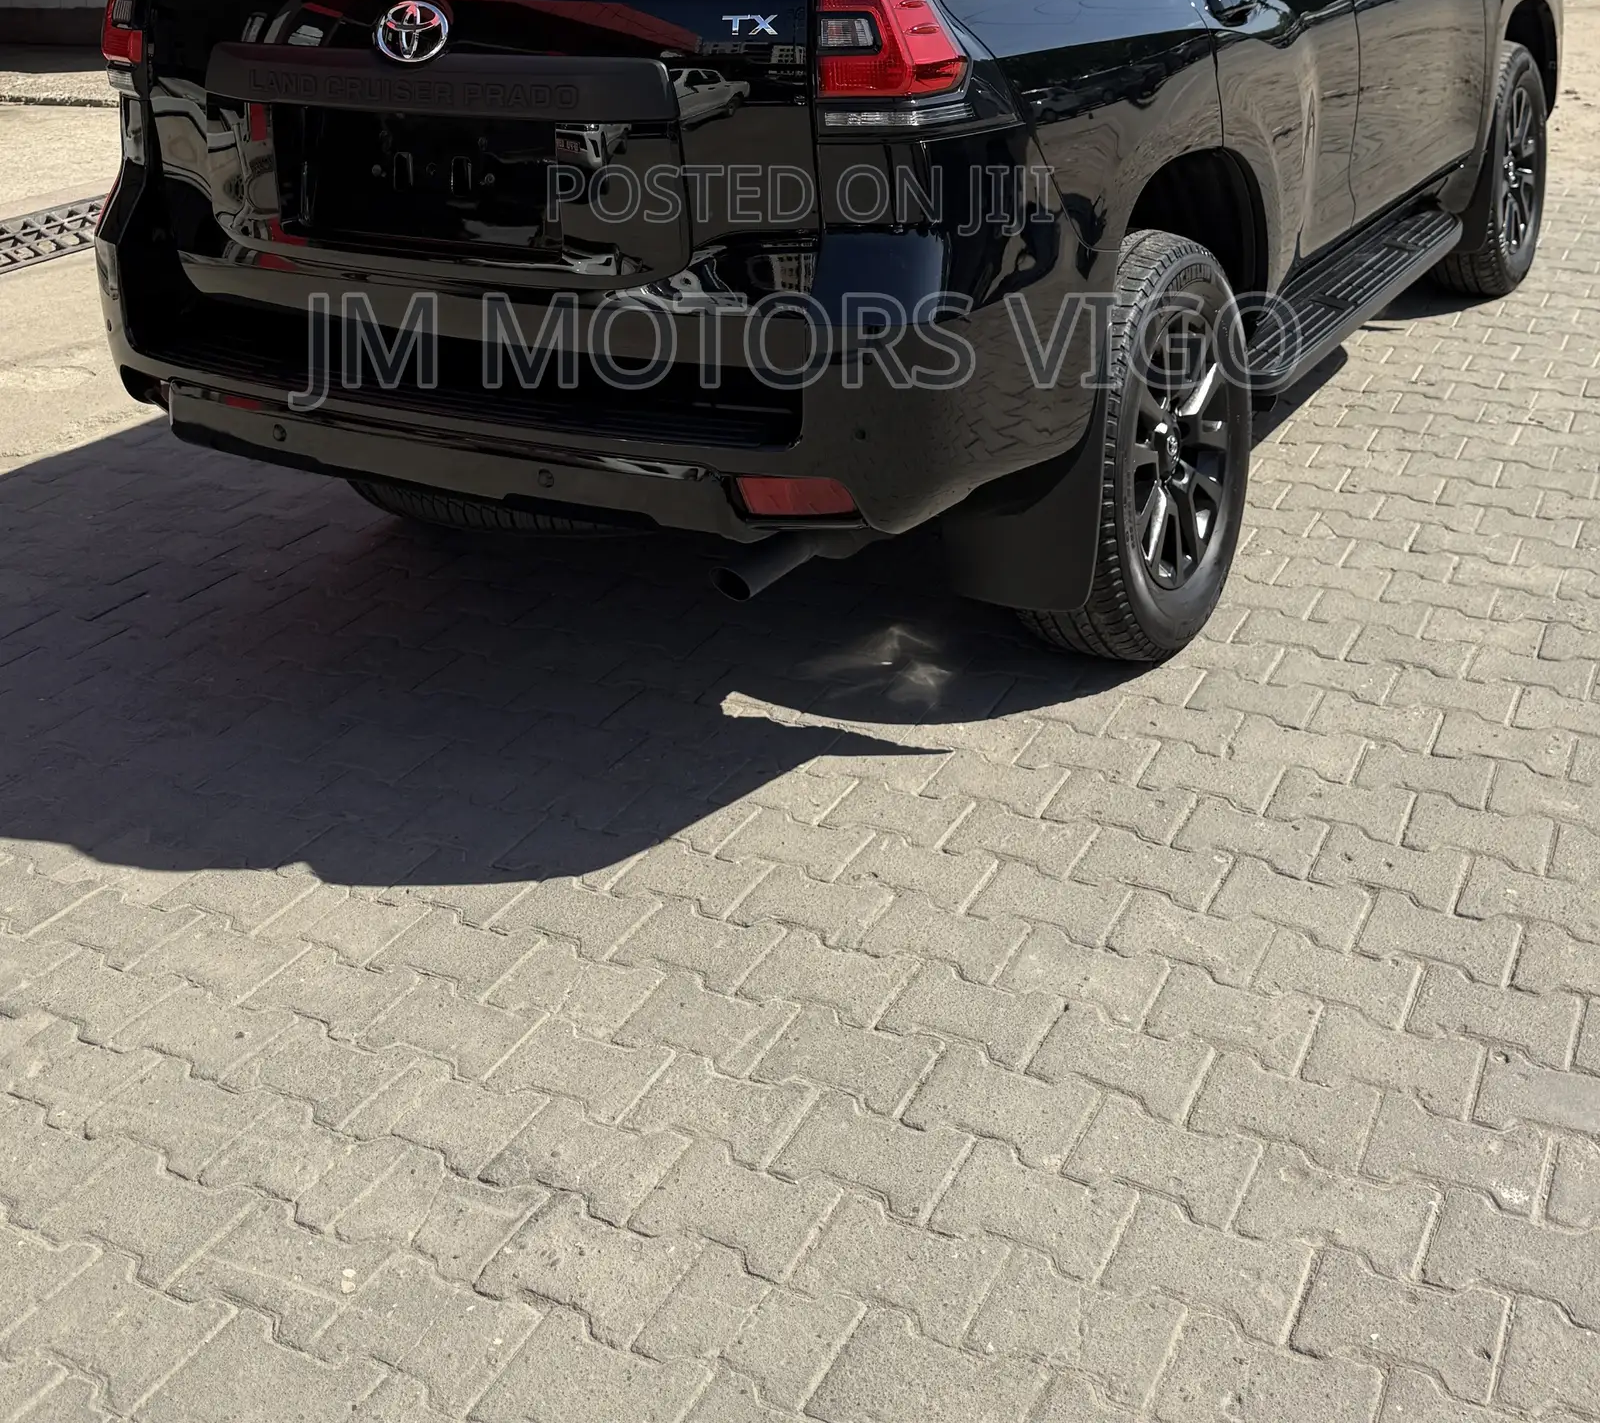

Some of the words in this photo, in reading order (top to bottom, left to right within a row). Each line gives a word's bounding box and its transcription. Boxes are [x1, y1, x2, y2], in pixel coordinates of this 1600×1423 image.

[722, 14, 778, 35] TX
[249, 69, 316, 98] LAND
[325, 74, 452, 105] CRUISER
[463, 82, 578, 109] PRADO
